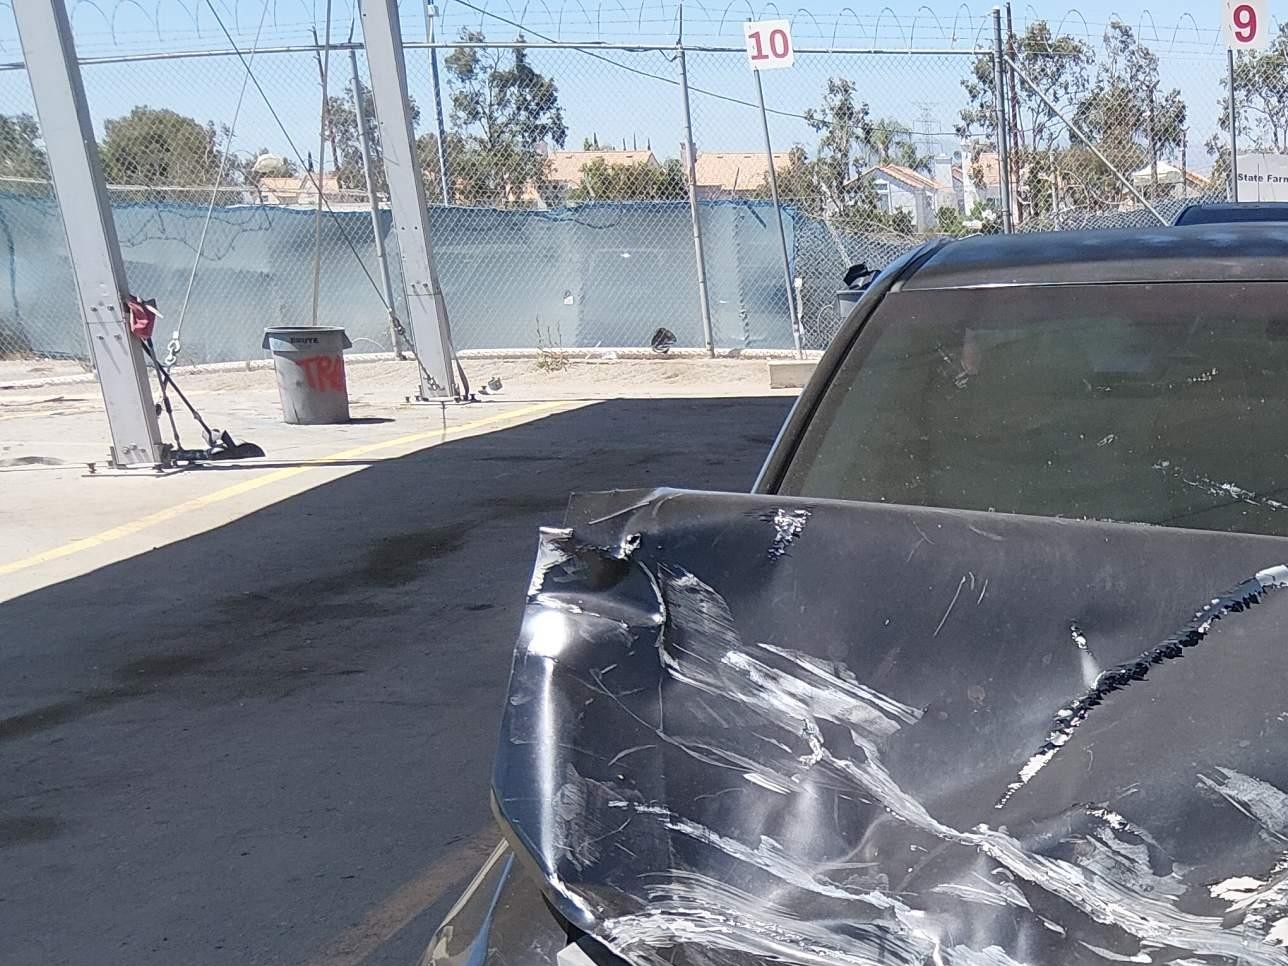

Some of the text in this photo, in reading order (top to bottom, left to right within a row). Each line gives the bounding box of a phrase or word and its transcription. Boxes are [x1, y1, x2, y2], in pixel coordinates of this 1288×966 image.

[1232, 4, 1257, 43] 9
[748, 29, 789, 60] 10
[1237, 173, 1264, 183] State
